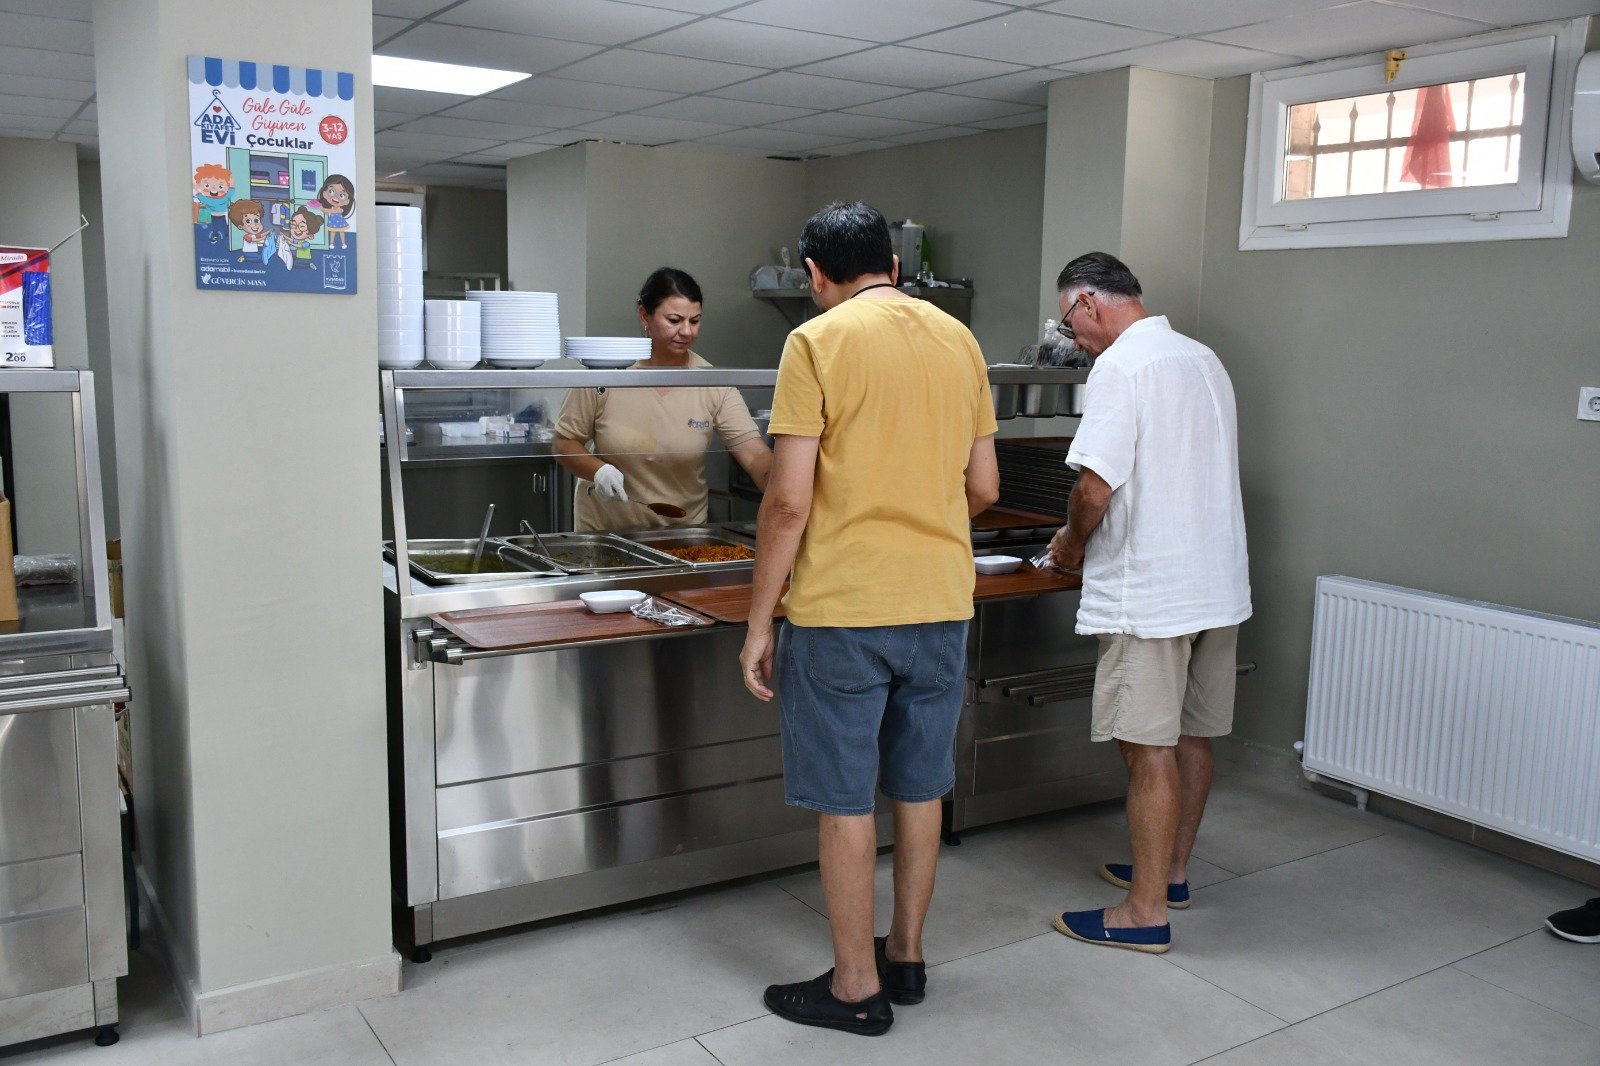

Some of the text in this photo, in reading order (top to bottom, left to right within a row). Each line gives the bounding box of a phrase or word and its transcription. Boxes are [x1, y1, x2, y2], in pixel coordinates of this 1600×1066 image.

[242, 97, 313, 116] Güle Güle
[201, 114, 234, 127] ADA
[252, 115, 306, 138] Giyinen
[321, 122, 345, 133] 3-12
[246, 133, 314, 150] Çocuklar
[326, 132, 342, 141] YAŞ
[6, 352, 27, 362] 200
